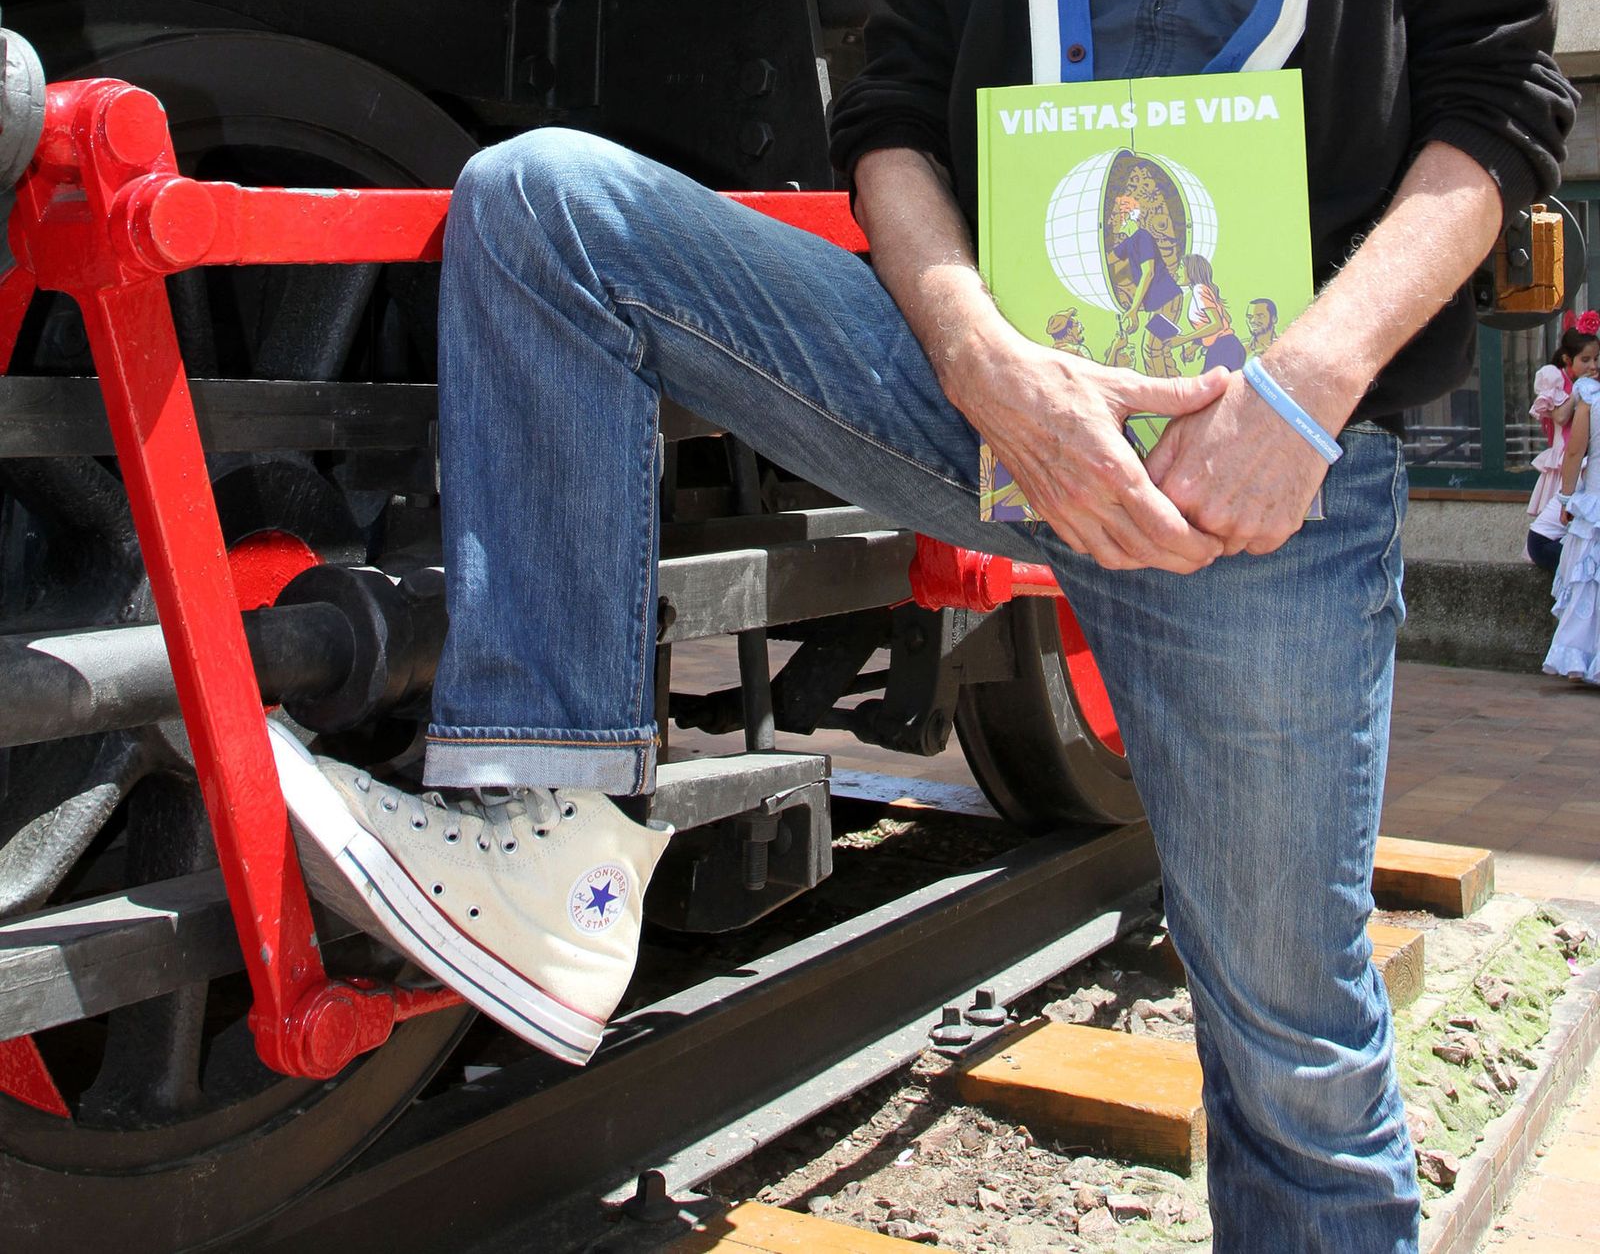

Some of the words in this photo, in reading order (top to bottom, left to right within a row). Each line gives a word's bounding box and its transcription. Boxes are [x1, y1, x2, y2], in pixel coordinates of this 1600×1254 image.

[999, 101, 1138, 136] VIÑETAS
[1147, 100, 1187, 128] DE
[1195, 94, 1280, 123] VIDA
[586, 868, 626, 894] CONVERSE
[573, 905, 585, 923] ALL
[585, 916, 611, 929] STAR
